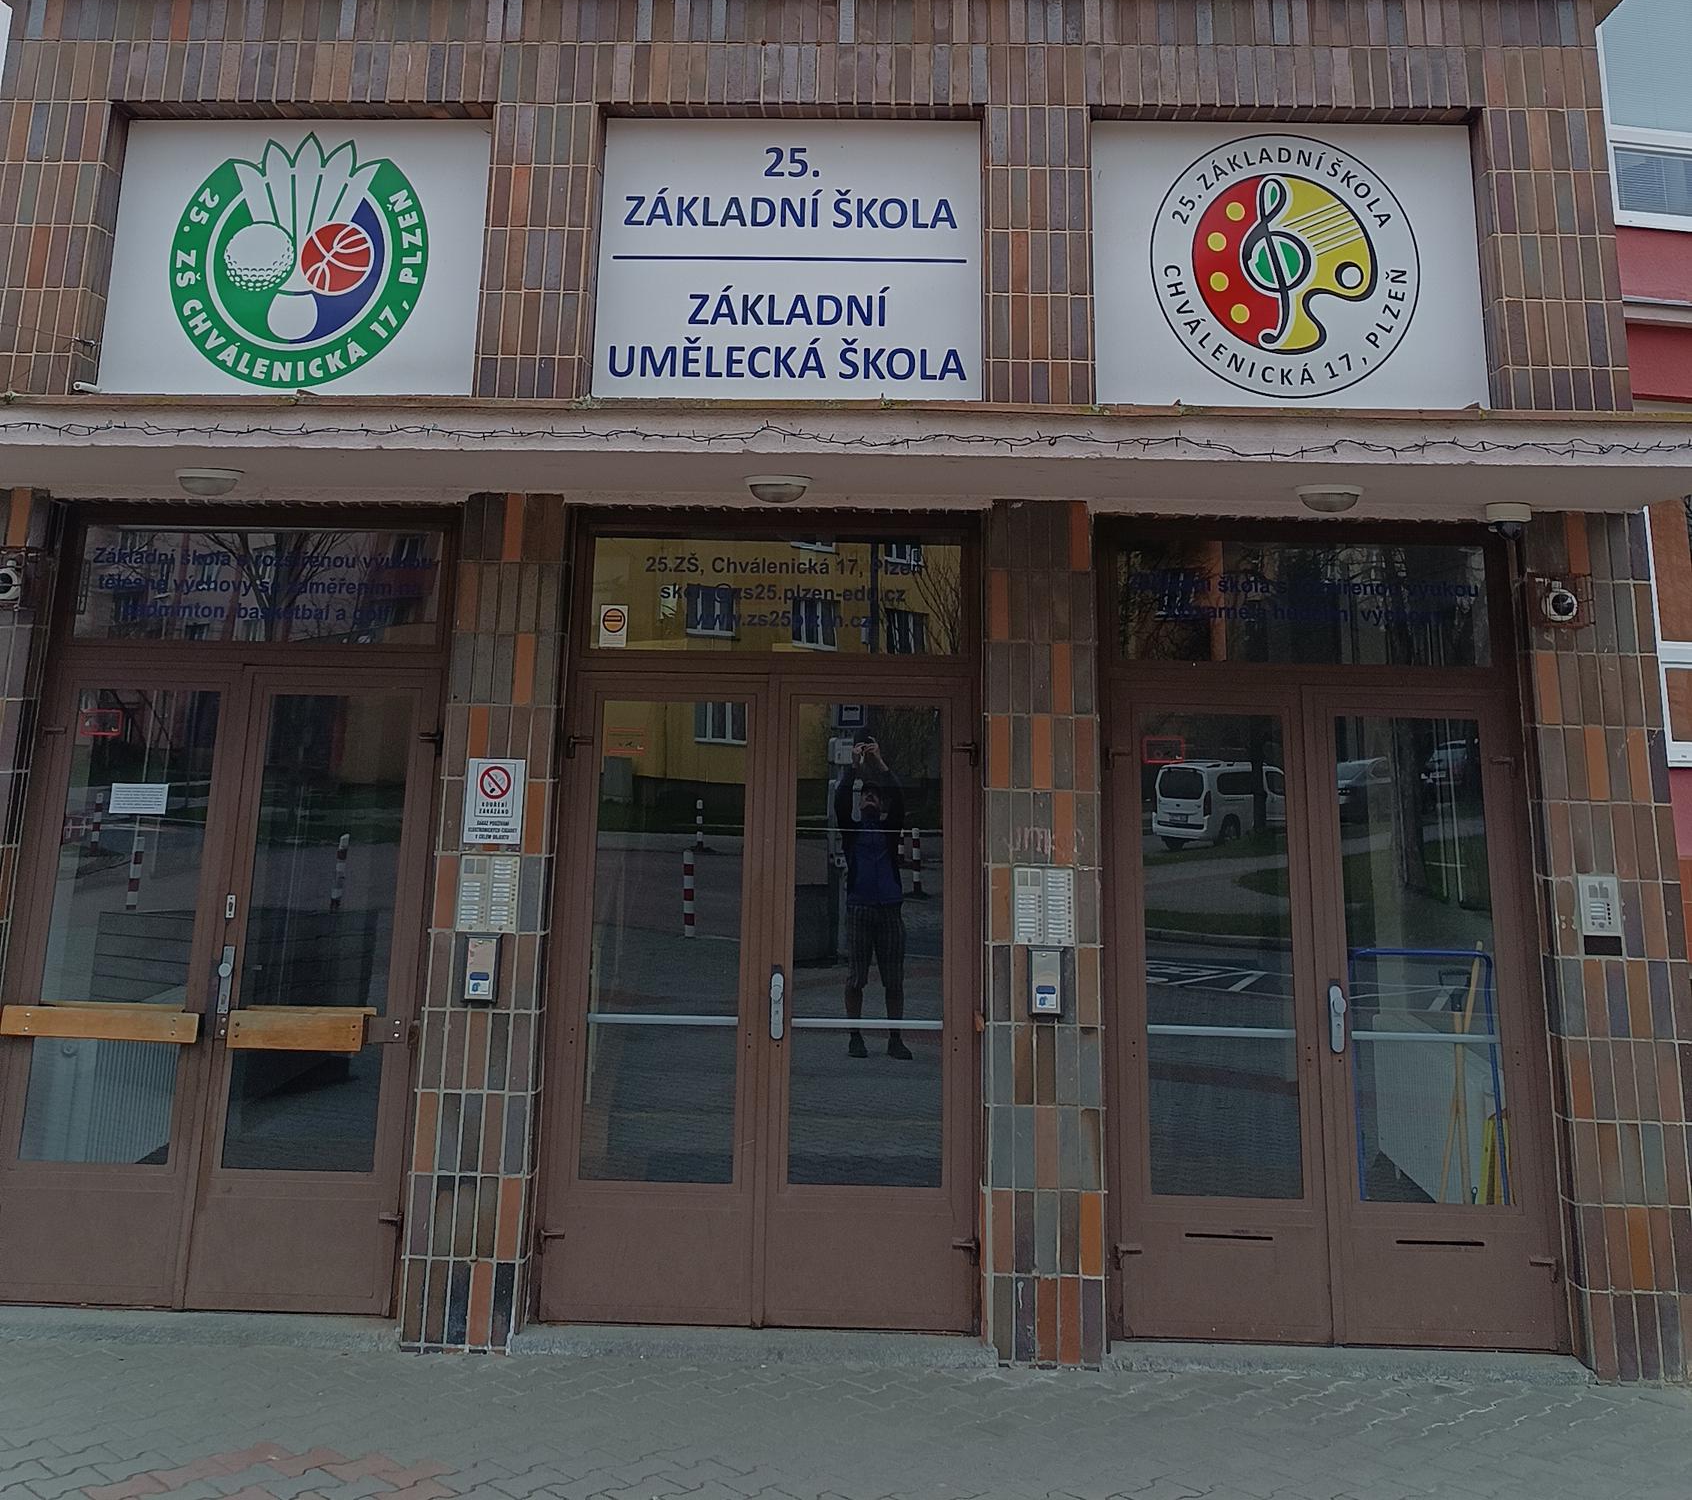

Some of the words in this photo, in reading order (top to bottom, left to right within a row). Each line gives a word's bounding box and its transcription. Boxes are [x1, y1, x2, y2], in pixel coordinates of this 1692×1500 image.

[764, 146, 820, 178] 25.
[183, 187, 221, 233] 25.
[623, 187, 823, 229] ZÁKLADNÍ
[832, 188, 958, 230] ŠKOLA
[1326, 157, 1392, 228] ŠKOLA
[386, 188, 424, 285] PLZEŇ
[176, 249, 201, 288] ZŠ
[687, 285, 890, 327] ZÁKLADNÍ
[1164, 264, 1316, 386] CHVÁLENICKÁ
[1323, 353, 1369, 380] 17,
[1365, 268, 1408, 349] PLZEŇ
[182, 299, 369, 382] CHVÁLENICKÁ
[608, 336, 826, 380] UMĚLECKÁ
[838, 337, 967, 382] ŠKOLA
[93, 547, 175, 567] Základní
[645, 552, 705, 576] 25.ZŠ,
[711, 556, 830, 575] Chválenická
[836, 558, 864, 578] 17,
[335, 608, 346, 621] a
